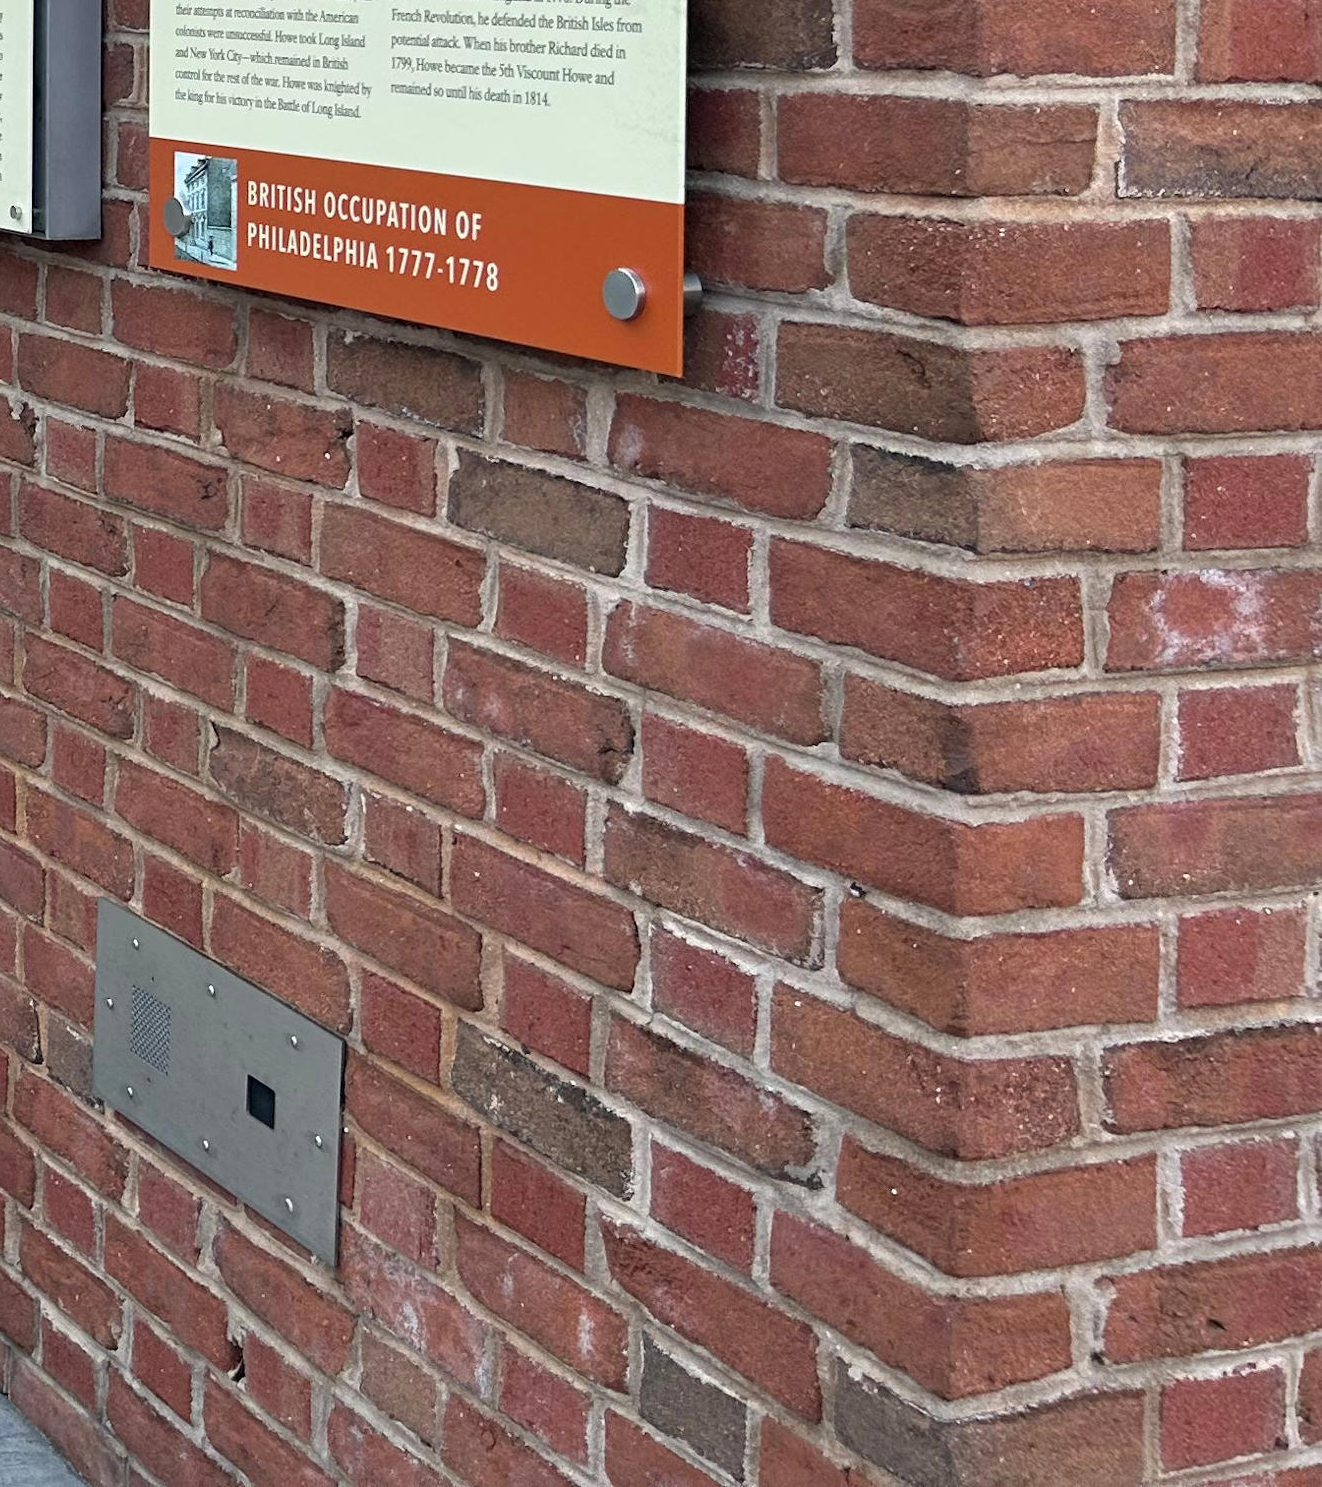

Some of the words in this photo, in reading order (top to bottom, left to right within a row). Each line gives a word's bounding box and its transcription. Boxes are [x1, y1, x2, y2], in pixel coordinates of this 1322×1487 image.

[391, 7, 421, 22] French
[477, 11, 489, 25] he
[490, 12, 536, 28] defended
[537, 14, 554, 29] the
[556, 14, 589, 30] British
[591, 16, 614, 32] Isles
[616, 17, 642, 32] from
[391, 33, 429, 48] potential
[462, 35, 491, 50] When
[493, 37, 507, 51] his
[509, 38, 546, 54] brother
[547, 40, 588, 56] Richard
[589, 43, 613, 58] died
[615, 44, 626, 59] in
[415, 57, 442, 72] Howe
[444, 59, 480, 75] became
[481, 61, 496, 76] the
[498, 63, 514, 77] 5th
[516, 64, 560, 81] Viscount
[562, 67, 592, 84] Howe
[594, 70, 614, 85] and
[390, 82, 431, 96] remained
[433, 86, 444, 97] so
[445, 85, 466, 99] until
[468, 86, 482, 100] his
[483, 87, 510, 102] death
[512, 90, 522, 103] in
[247, 180, 315, 214] BRITISH
[323, 191, 446, 235] OCCUPATION
[455, 210, 481, 240] OF
[247, 222, 378, 269] PHILADELPHIA
[386, 245, 497, 291] 1777-1778
